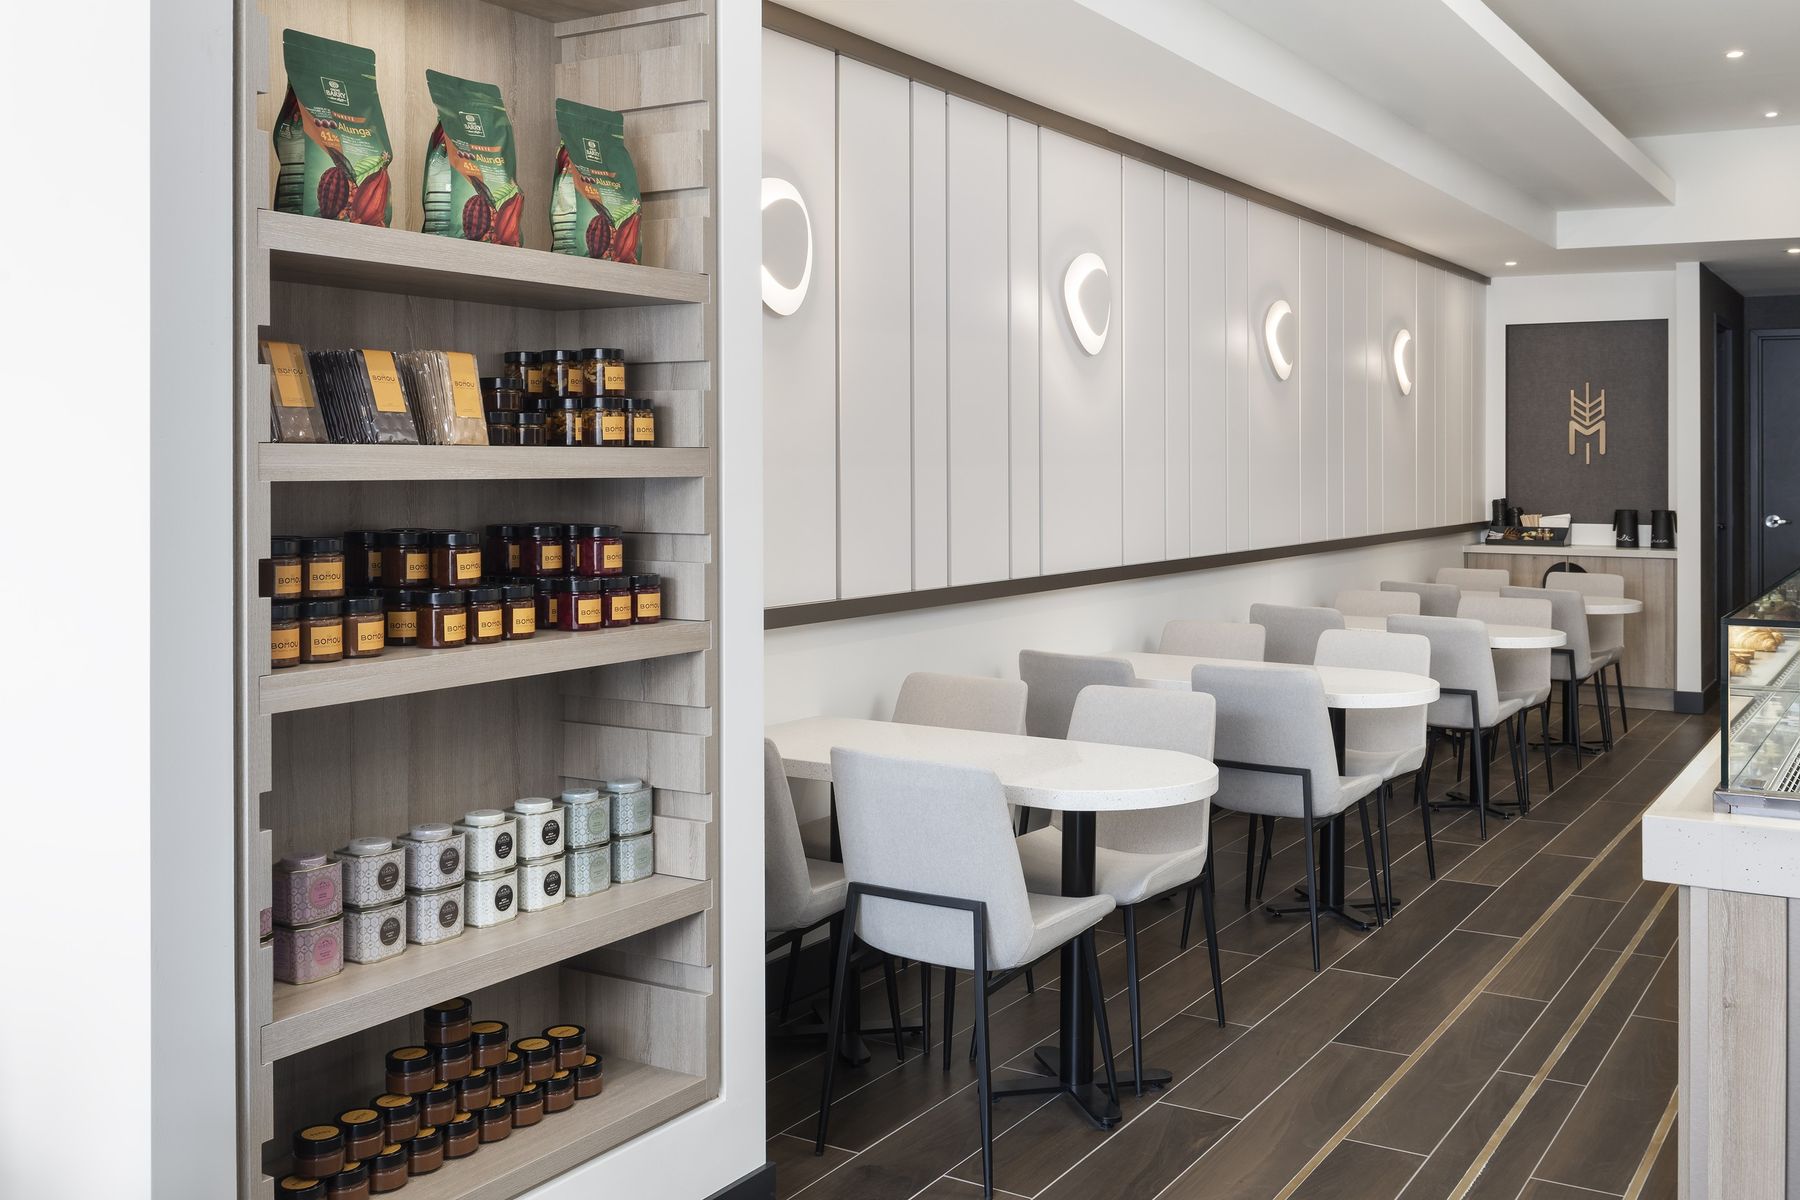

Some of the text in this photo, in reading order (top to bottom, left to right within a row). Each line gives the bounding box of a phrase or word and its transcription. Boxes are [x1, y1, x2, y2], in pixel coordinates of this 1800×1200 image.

[338, 122, 372, 138] Alunga
[320, 130, 340, 143] 41%
[372, 374, 396, 382] BOMOU
[454, 380, 475, 388] BOMOU
[312, 573, 341, 581] BOMOU
[271, 641, 298, 649] BOMOU
[313, 637, 341, 646] BOMOU
